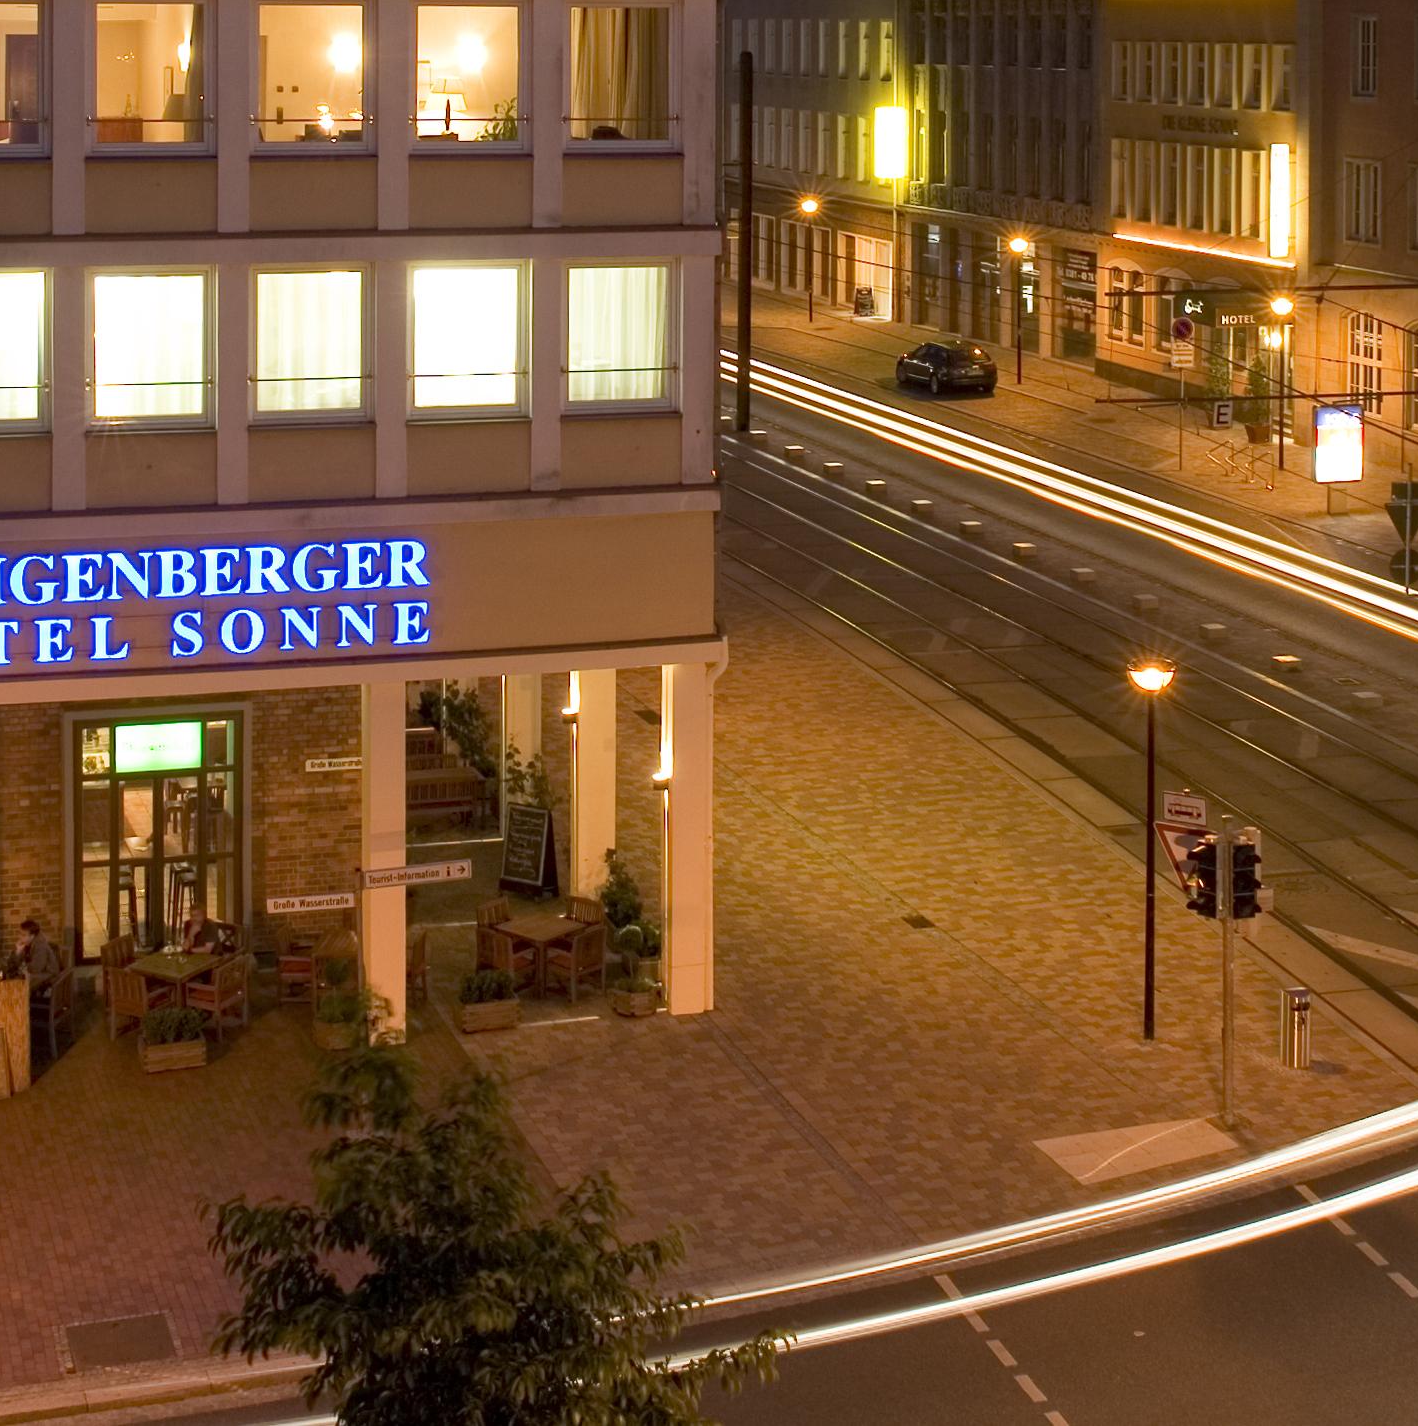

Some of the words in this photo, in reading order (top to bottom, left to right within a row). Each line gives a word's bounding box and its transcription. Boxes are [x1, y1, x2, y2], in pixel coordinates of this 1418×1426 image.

[1221, 314, 1256, 325] HOTEL
[1216, 404, 1230, 424] E
[171, 600, 431, 658] SONNE
[368, 869, 440, 884] Tourist-Information
[273, 900, 296, 910] Große
[298, 896, 350, 908] Wasserstraße
